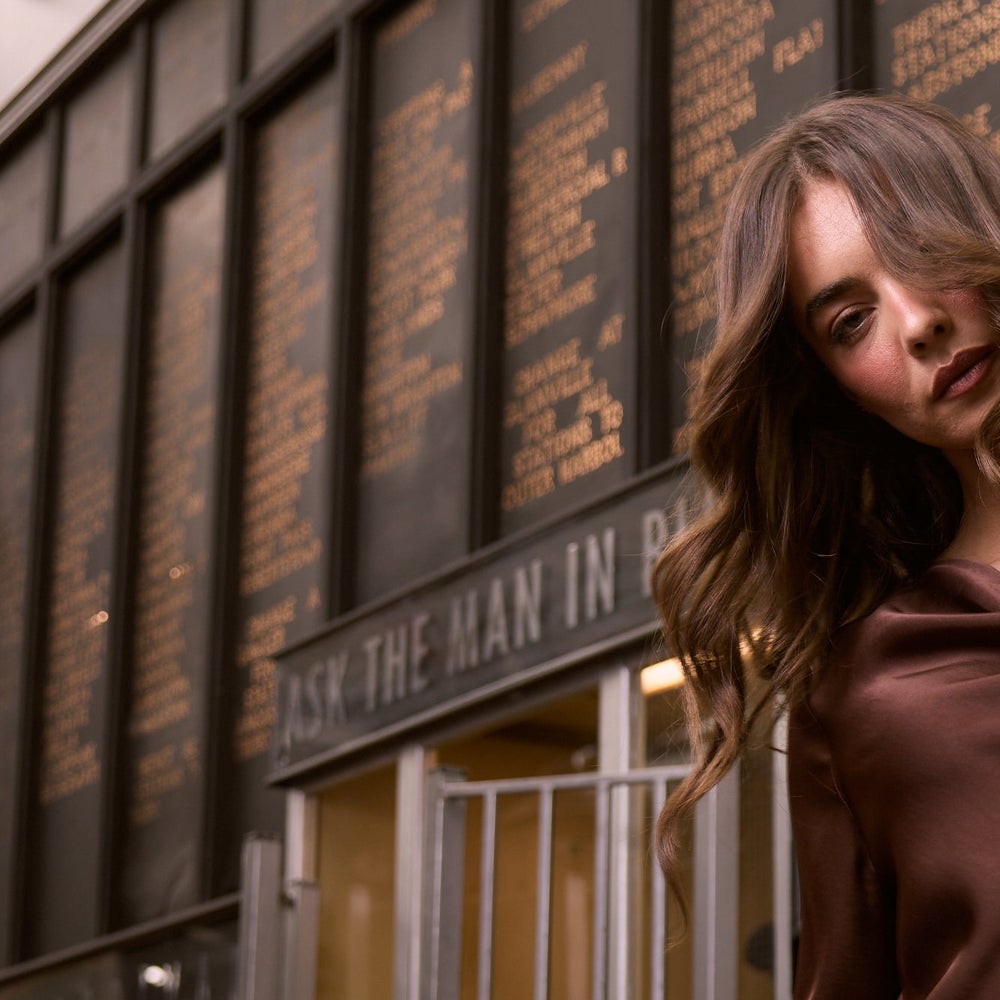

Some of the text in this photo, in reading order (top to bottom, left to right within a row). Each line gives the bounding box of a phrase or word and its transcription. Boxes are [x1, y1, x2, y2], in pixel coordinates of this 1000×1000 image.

[364, 613, 432, 713] THE
[447, 559, 543, 677] MAN
[564, 526, 617, 630] IN
